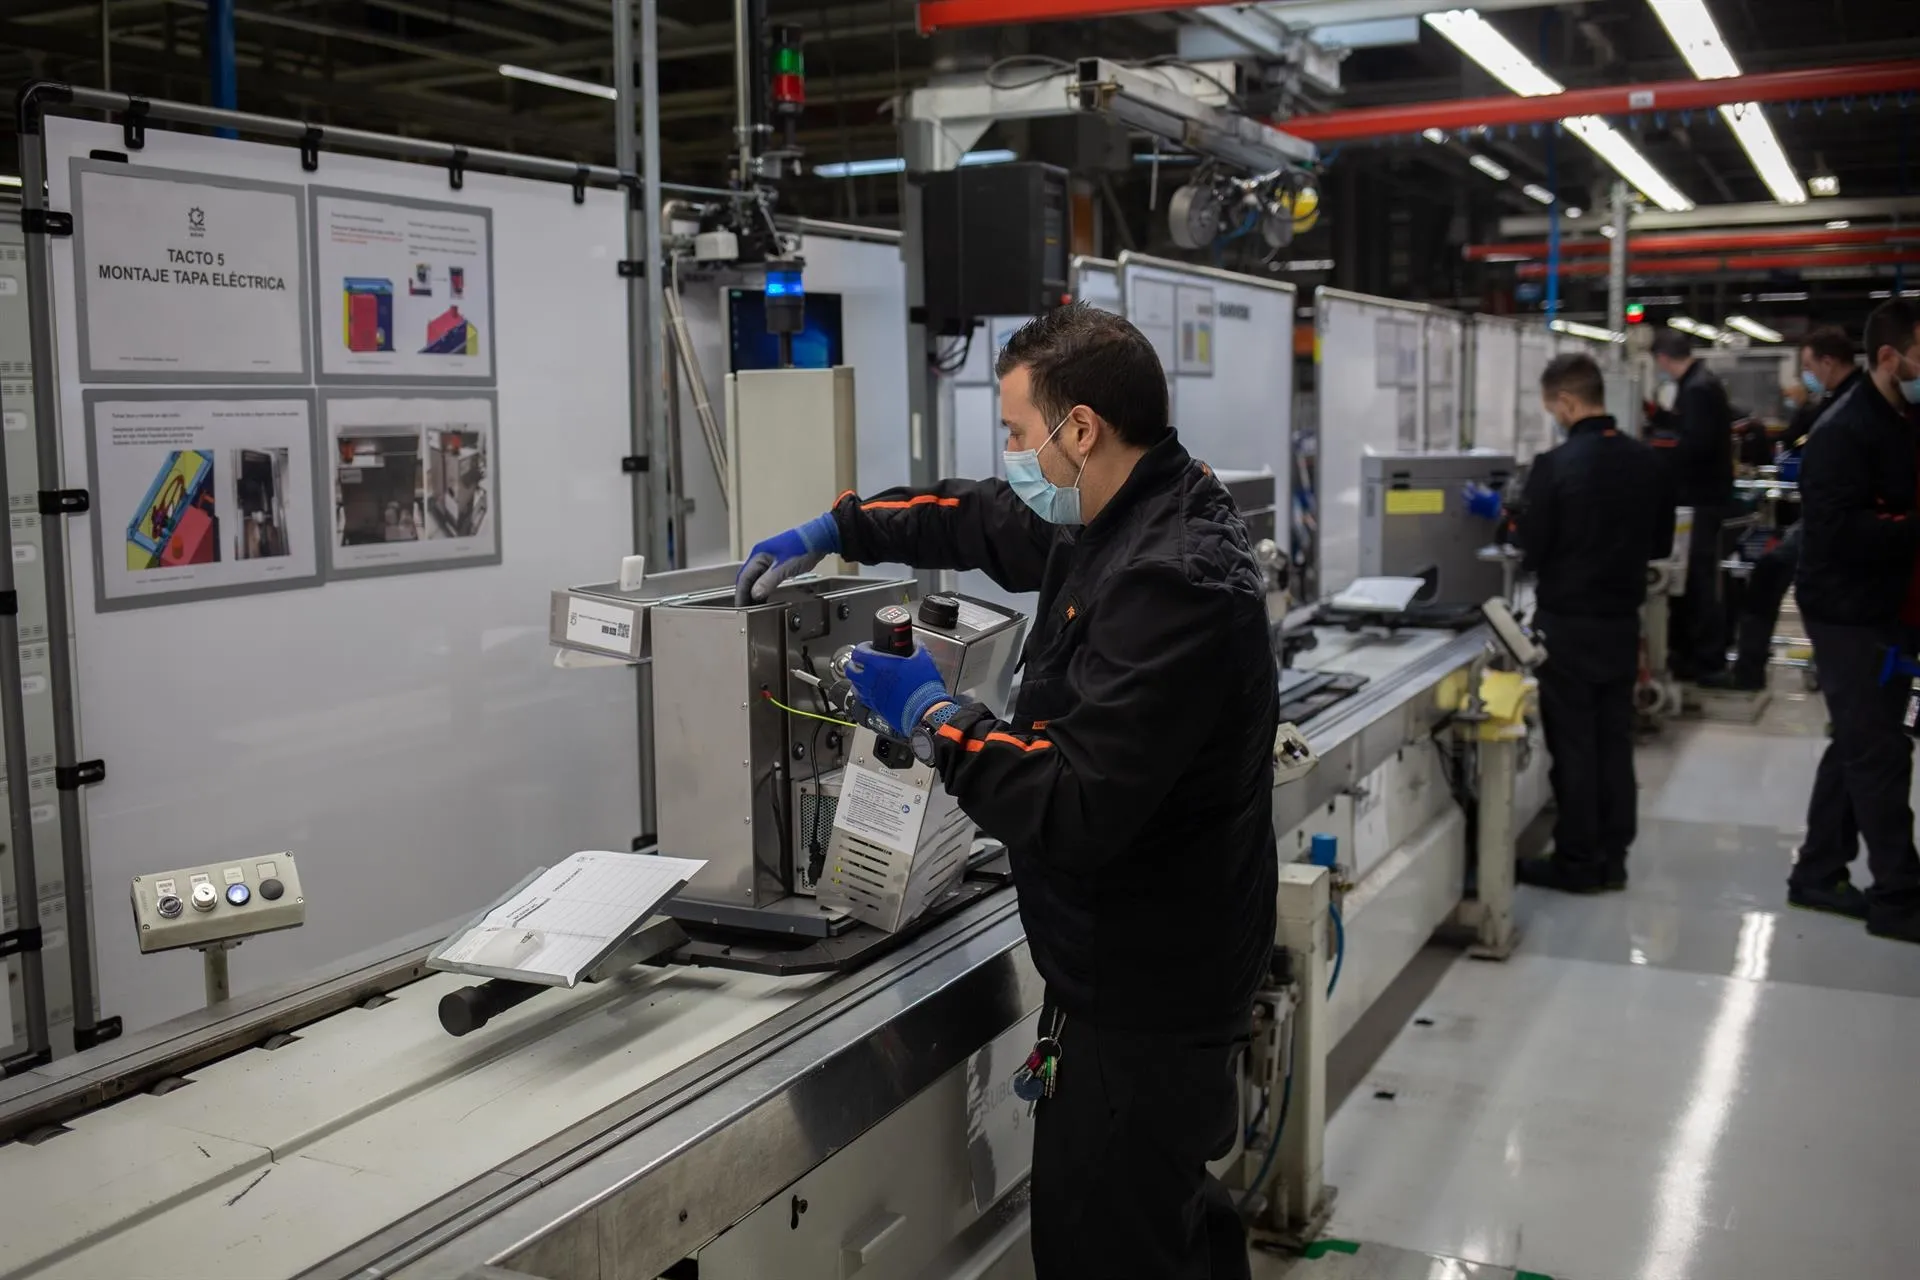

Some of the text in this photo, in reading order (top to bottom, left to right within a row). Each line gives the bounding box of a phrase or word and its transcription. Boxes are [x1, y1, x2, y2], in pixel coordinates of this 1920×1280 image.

[167, 249, 225, 266] TACTO 5
[99, 264, 286, 290] MONTAJE TAPA ELÉCTRICA
